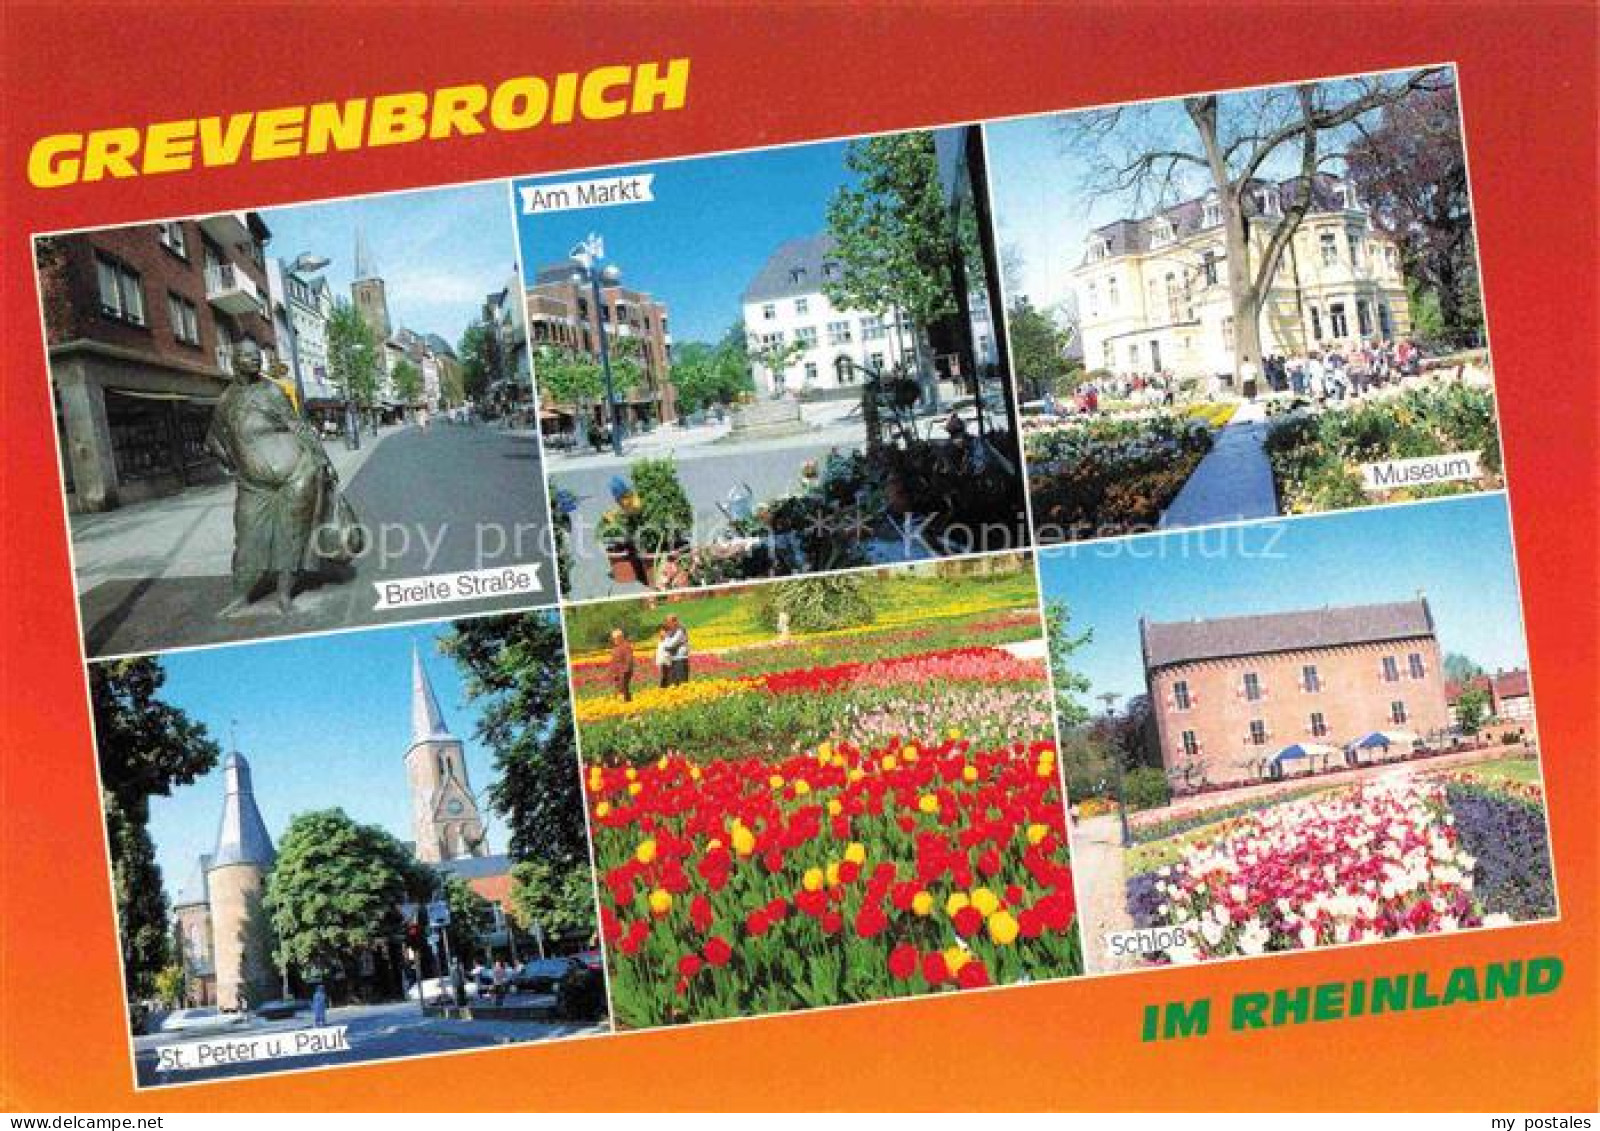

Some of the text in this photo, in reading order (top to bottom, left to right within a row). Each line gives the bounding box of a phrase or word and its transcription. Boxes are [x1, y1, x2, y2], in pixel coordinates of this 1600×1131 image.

[27, 58, 691, 189] GREVENBROICH
[530, 178, 643, 211] Am Markt
[1373, 459, 1470, 485] Museum
[385, 570, 531, 604] Breite Straße
[1111, 927, 1187, 955] Schloß
[1141, 956, 1565, 1042] IM RHEINLAND
[161, 1028, 346, 1069] St. Peter u. Paul
